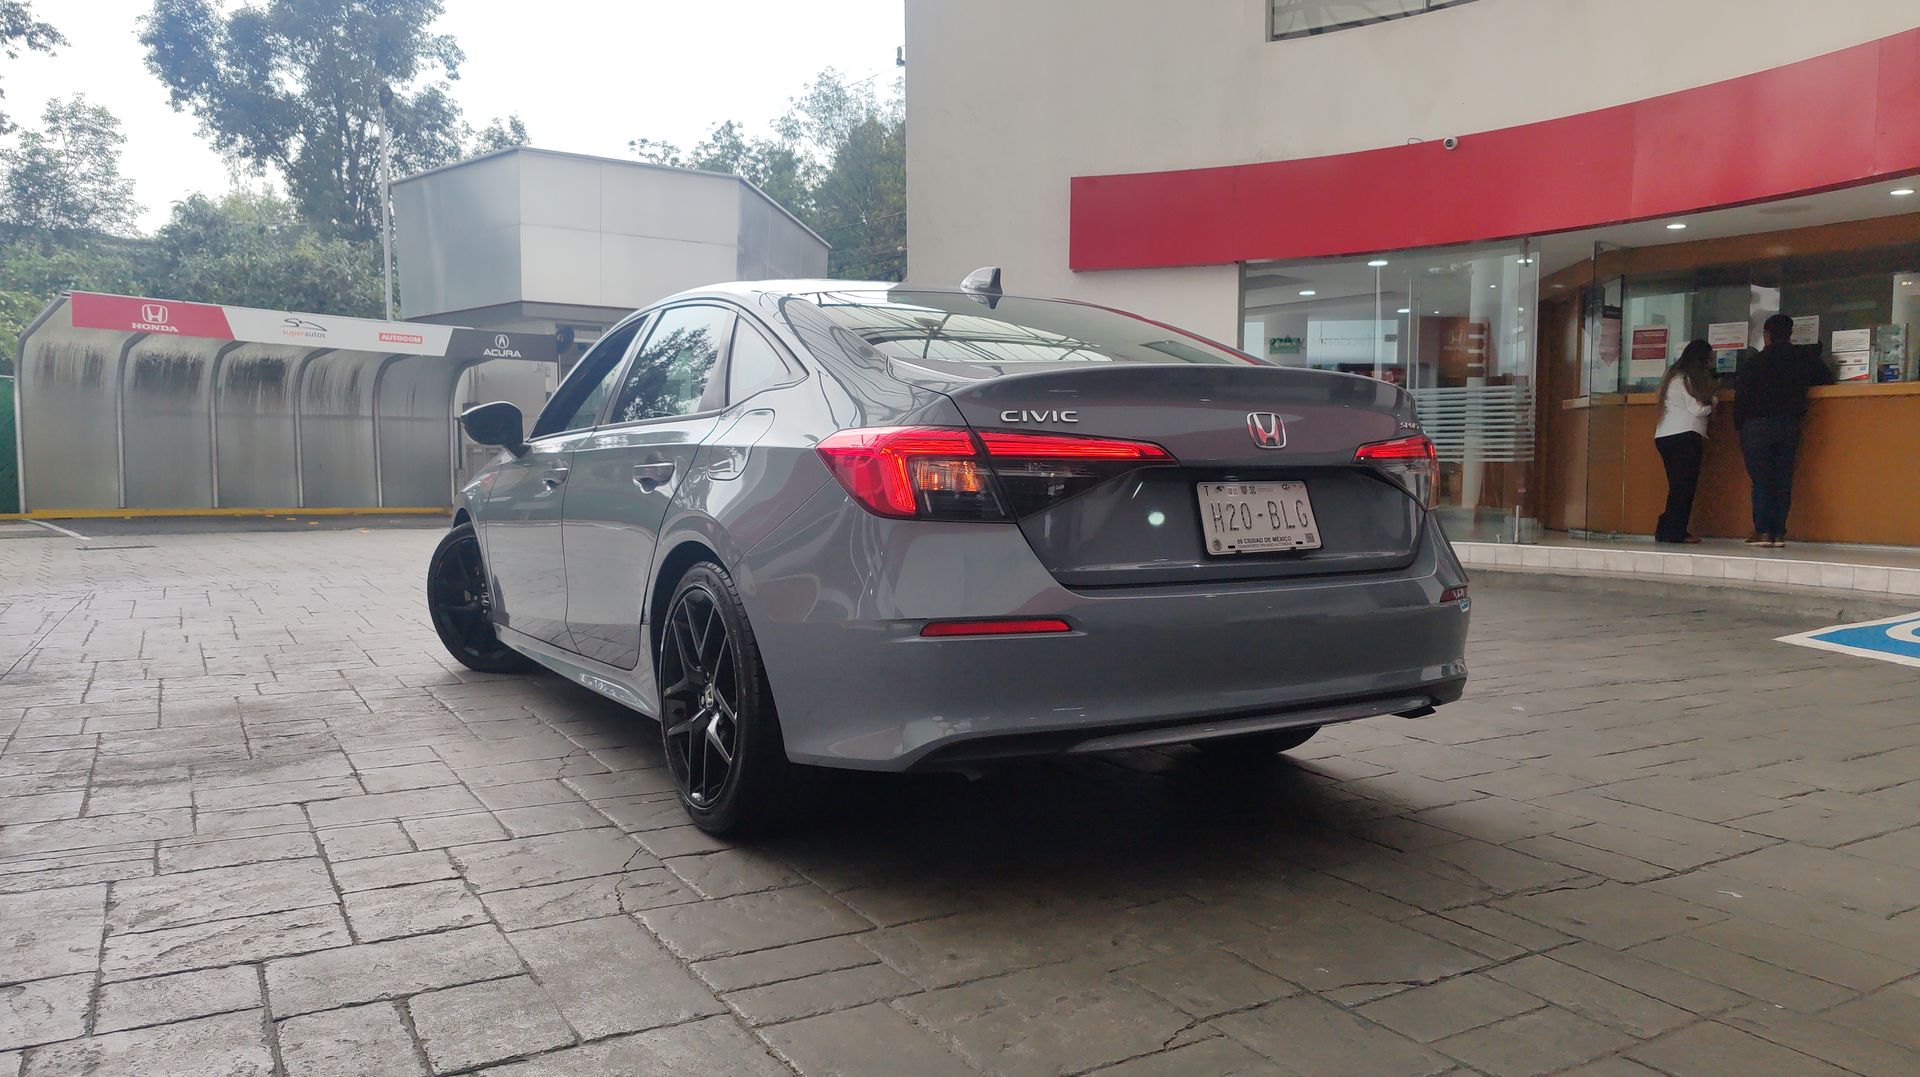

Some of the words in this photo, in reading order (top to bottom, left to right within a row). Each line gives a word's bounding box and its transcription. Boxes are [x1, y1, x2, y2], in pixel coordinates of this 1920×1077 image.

[131, 322, 179, 333] HONDA
[282, 329, 326, 338] superautos
[381, 334, 421, 343] AUTOCOM
[483, 348, 522, 358] ACURA
[1000, 410, 1079, 422] CIVIC
[1210, 499, 1309, 533] H20-BLG
